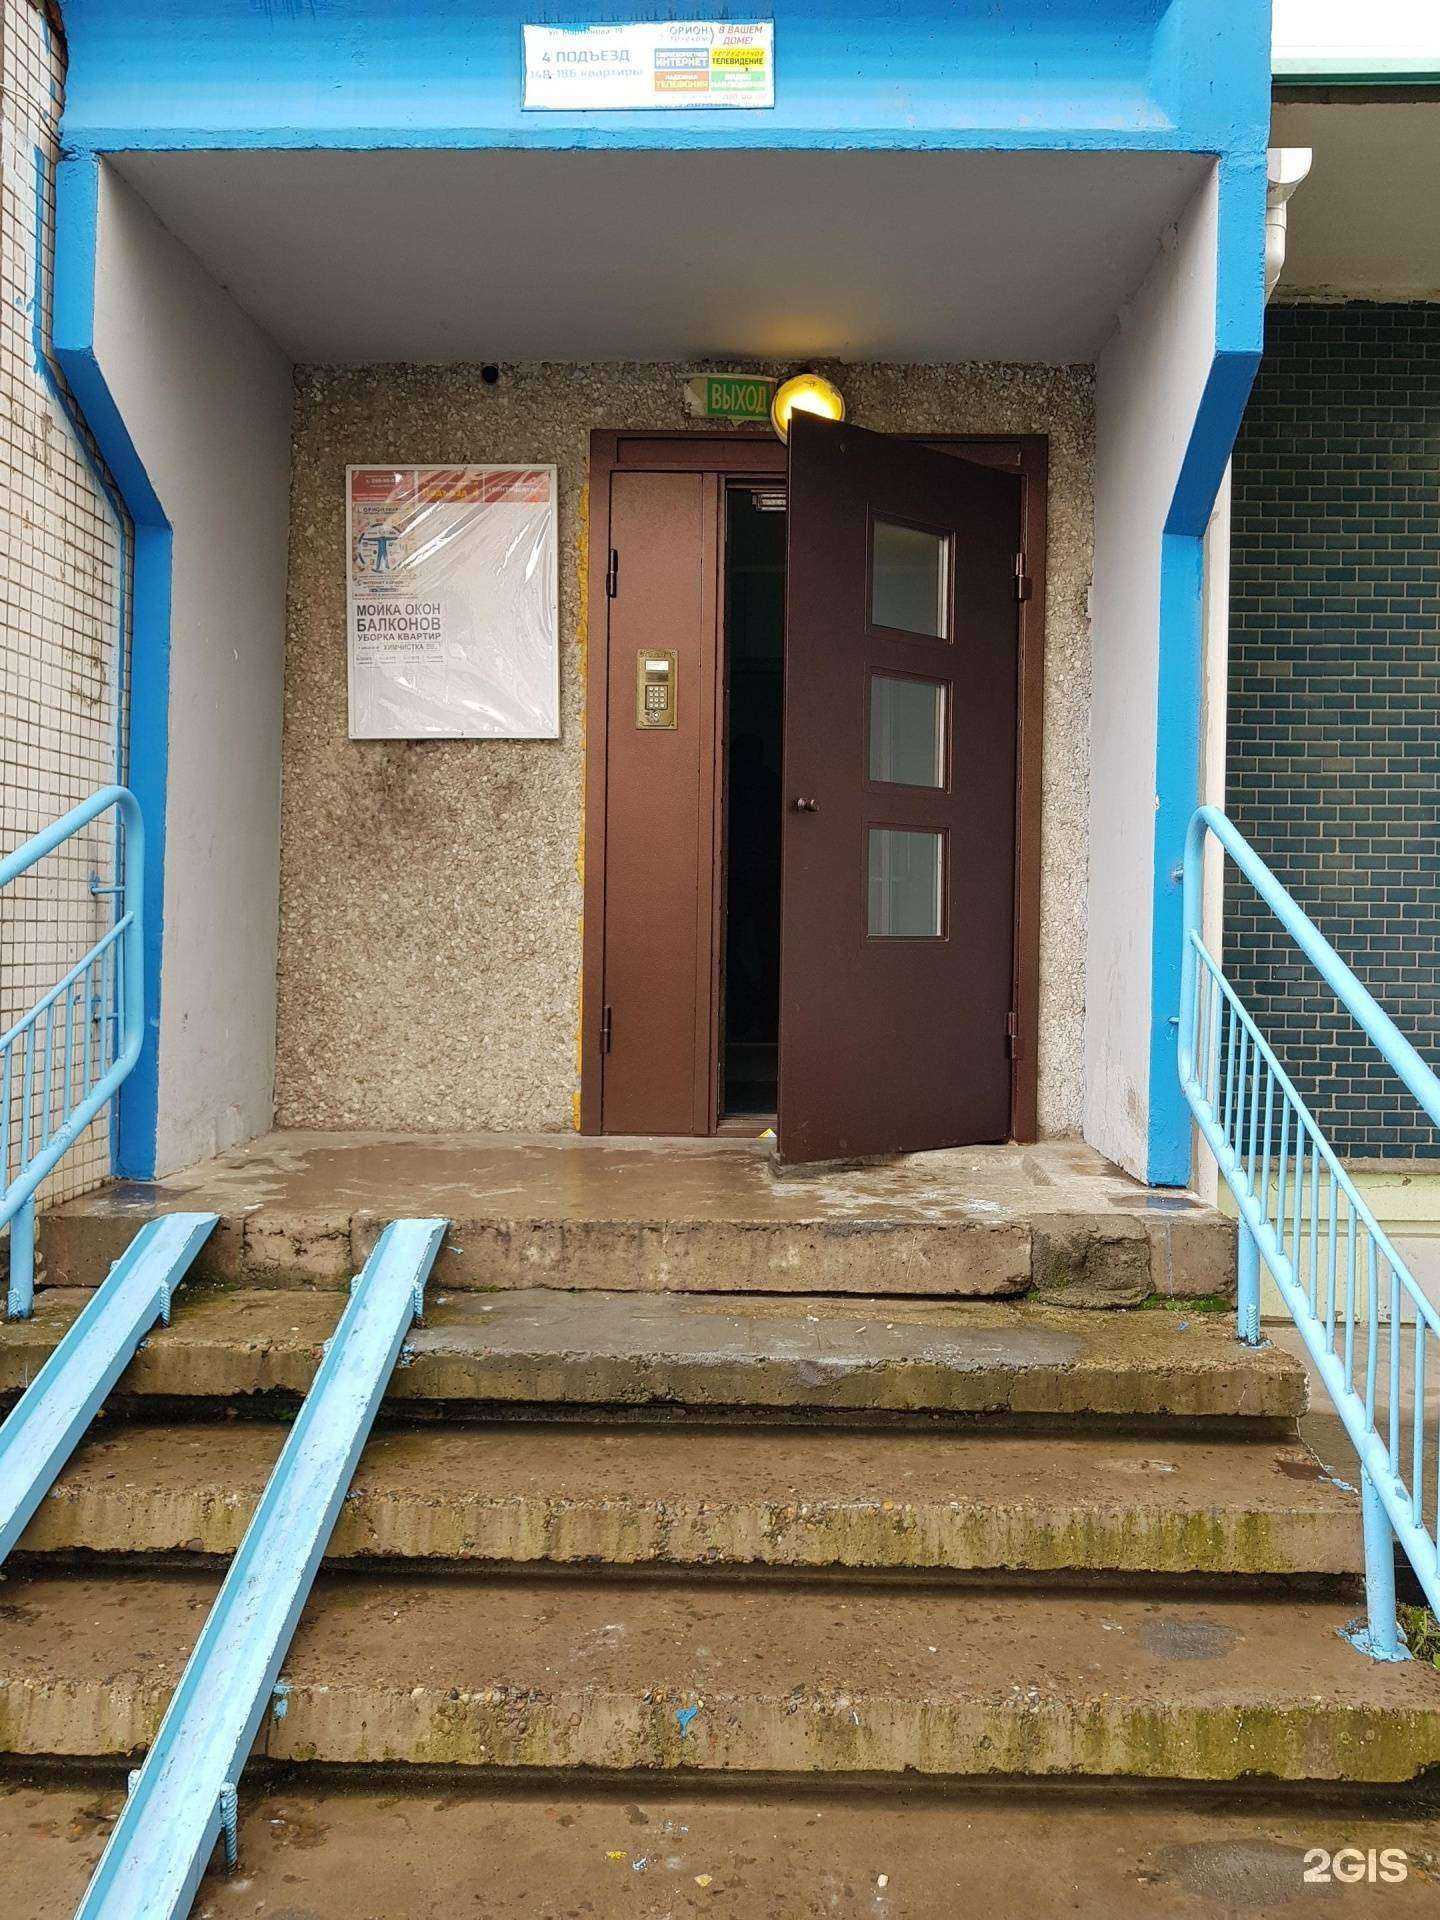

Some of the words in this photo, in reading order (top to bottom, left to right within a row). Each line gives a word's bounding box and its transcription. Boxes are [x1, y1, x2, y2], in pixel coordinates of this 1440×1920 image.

[669, 25, 708, 35] ОРИОН
[718, 25, 725, 34] В
[727, 25, 763, 34] ВАШЕМ
[541, 51, 551, 63] 4
[556, 50, 631, 63] ПОДЪЕЗД
[711, 57, 764, 66] ТЕЛЕВИДЕНИЕ
[711, 383, 768, 413] ВЫХОД
[356, 602, 402, 617] МОЙКА
[405, 602, 441, 616] ОКОН
[356, 617, 441, 632] БАЛКОНОВ
[357, 632, 396, 642] УБОРКА
[397, 632, 442, 641] КВАРТИР
